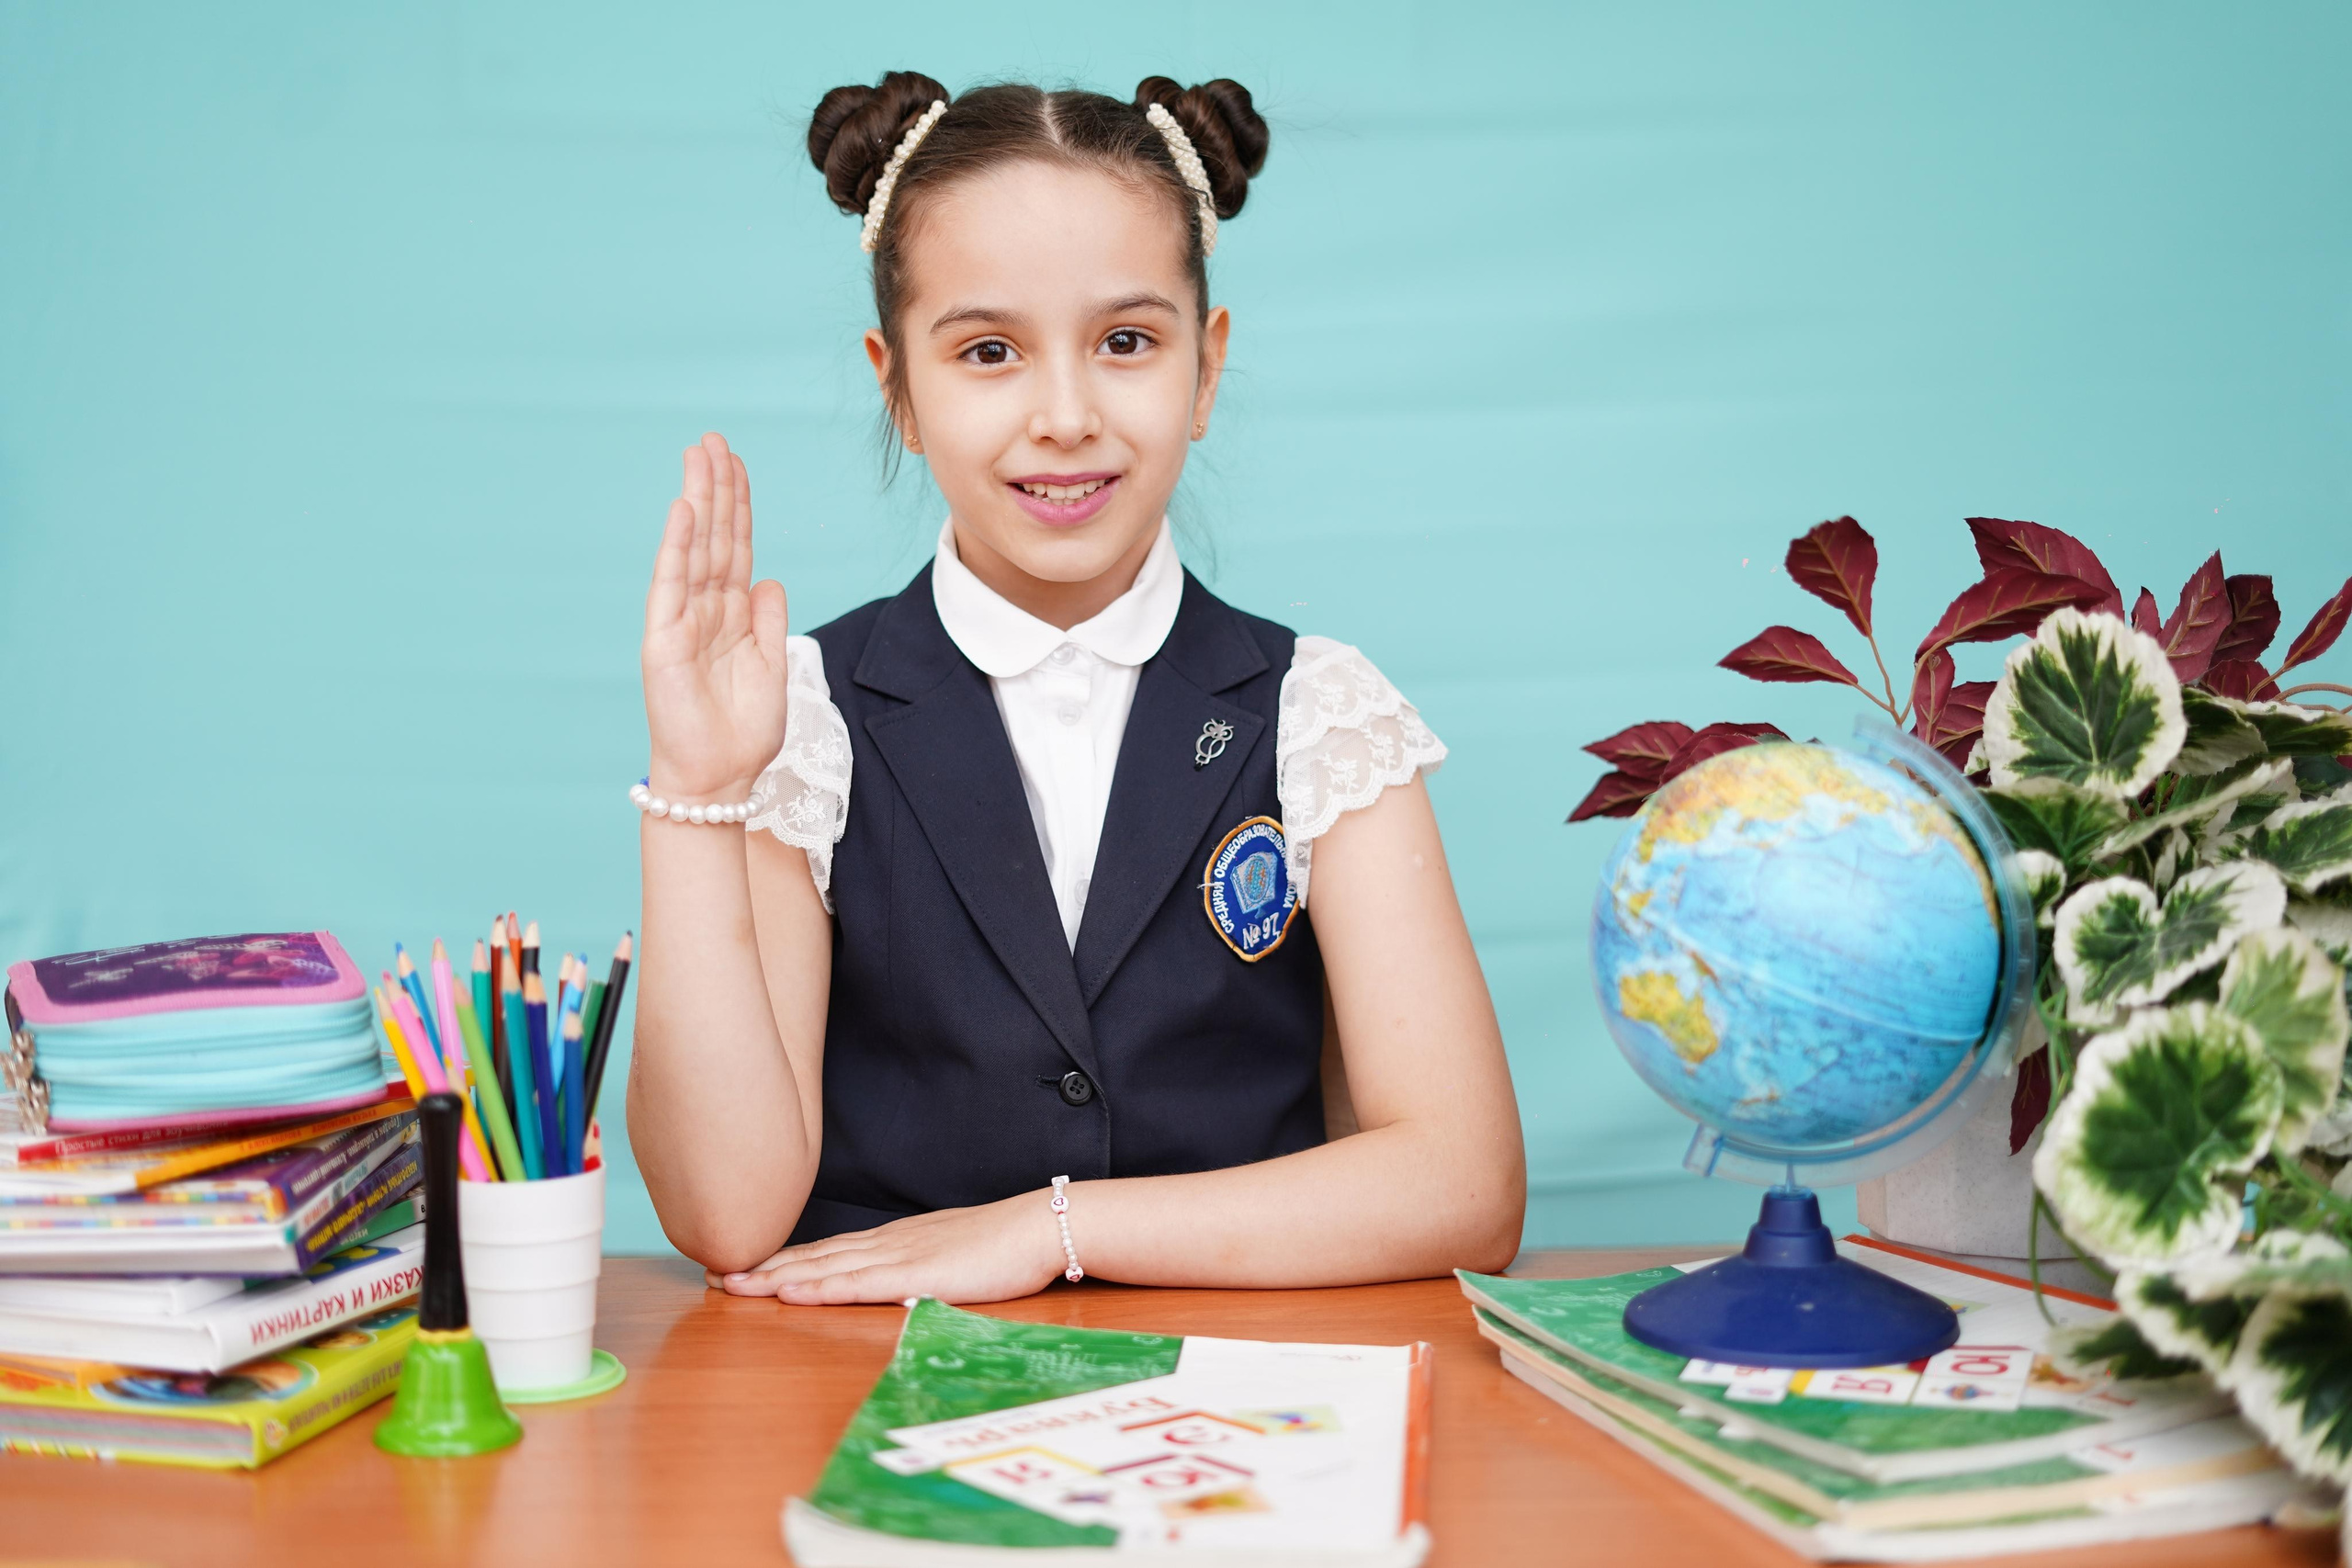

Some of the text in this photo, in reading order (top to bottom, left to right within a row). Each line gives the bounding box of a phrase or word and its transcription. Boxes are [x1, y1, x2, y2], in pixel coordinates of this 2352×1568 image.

[1214, 824, 1288, 880] ОБЩЕОБРАЗОВАТЕЛЬН
[108, 1134, 140, 1146] стихи
[142, 1129, 161, 1142] для
[249, 1266, 425, 1346] КАЗКИ И КАРТИНКИ
[942, 1395, 1177, 1450] Букварь
